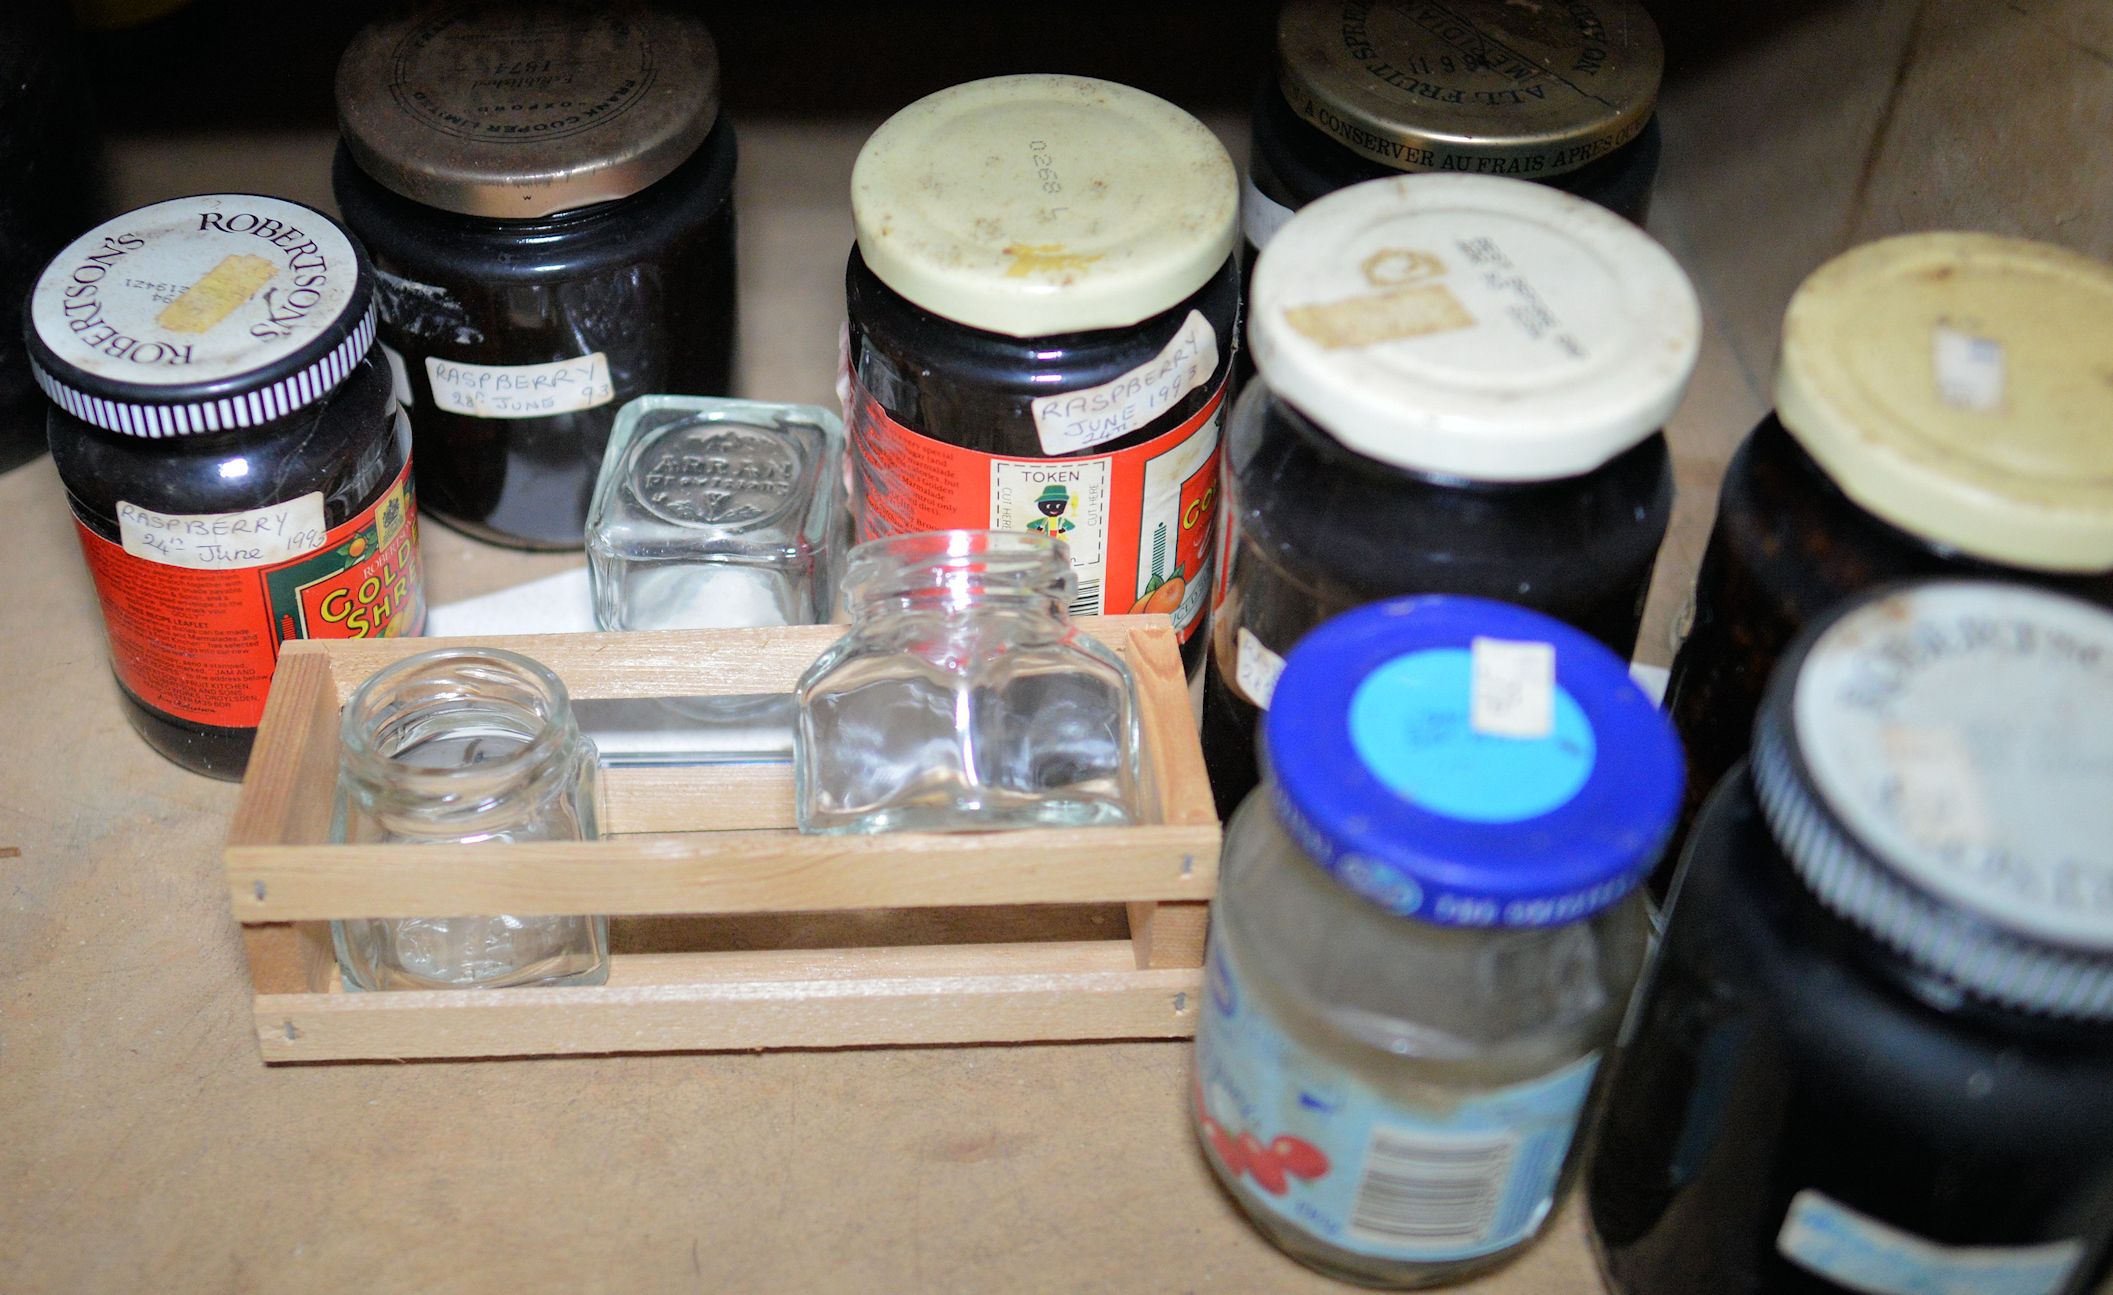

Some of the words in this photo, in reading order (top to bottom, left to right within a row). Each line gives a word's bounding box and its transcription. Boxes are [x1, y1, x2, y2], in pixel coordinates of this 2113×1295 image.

[493, 60, 551, 75] 1874
[1365, 63, 1466, 105] FRUIT
[1475, 83, 1546, 106] ALL
[582, 78, 637, 119] FRANK
[485, 113, 580, 135] COOPER
[1304, 101, 1314, 116] A
[1317, 107, 1435, 167] CONSERVER
[1439, 154, 1472, 171] AU
[1478, 156, 1546, 175] FRAIS
[1551, 134, 1613, 168] APRES
[199, 212, 327, 342] ROBERTSON'S
[64, 233, 195, 366] ROBERTSON'S
[435, 362, 595, 391] RASPBERRY
[1041, 331, 1198, 421] RASPBERRY
[492, 396, 556, 411] JUNE
[1063, 405, 1136, 437] JUNE
[1149, 364, 1198, 408] 1993
[902, 475, 946, 500] Marmalade
[1022, 470, 1081, 483] TOKEN
[1001, 487, 1013, 505] CUT
[1088, 484, 1099, 507] HERE
[121, 504, 288, 536] RASPBERRY
[937, 503, 958, 514] only
[1087, 507, 1099, 527] CUT
[196, 544, 264, 562] June
[320, 518, 420, 624] GOLDE
[346, 558, 418, 639] SHRE
[210, 682, 249, 690] KITCHEN
